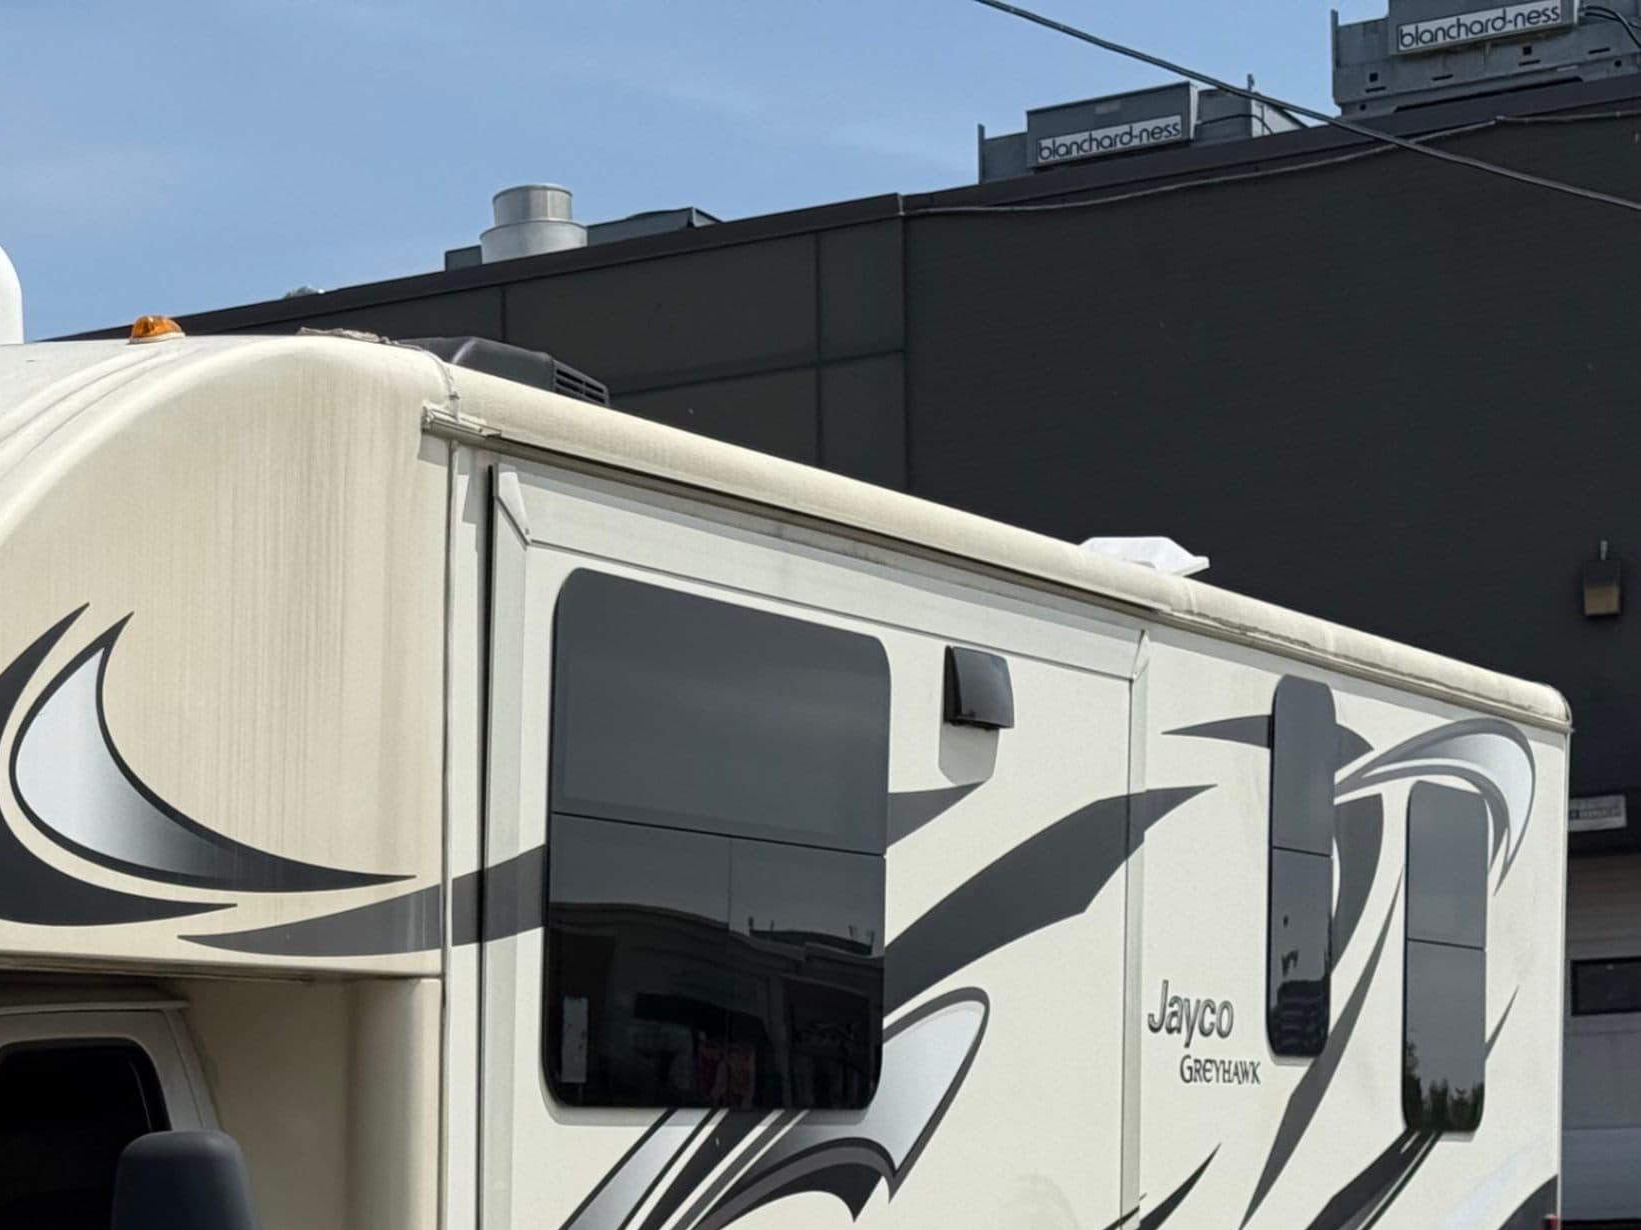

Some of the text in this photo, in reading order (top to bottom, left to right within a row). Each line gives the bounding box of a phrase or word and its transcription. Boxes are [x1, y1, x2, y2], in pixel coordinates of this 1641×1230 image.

[1400, 6, 1560, 48] blanchard-ness
[1038, 123, 1180, 160] blanchard-ness
[1147, 979, 1234, 1049] Jayco
